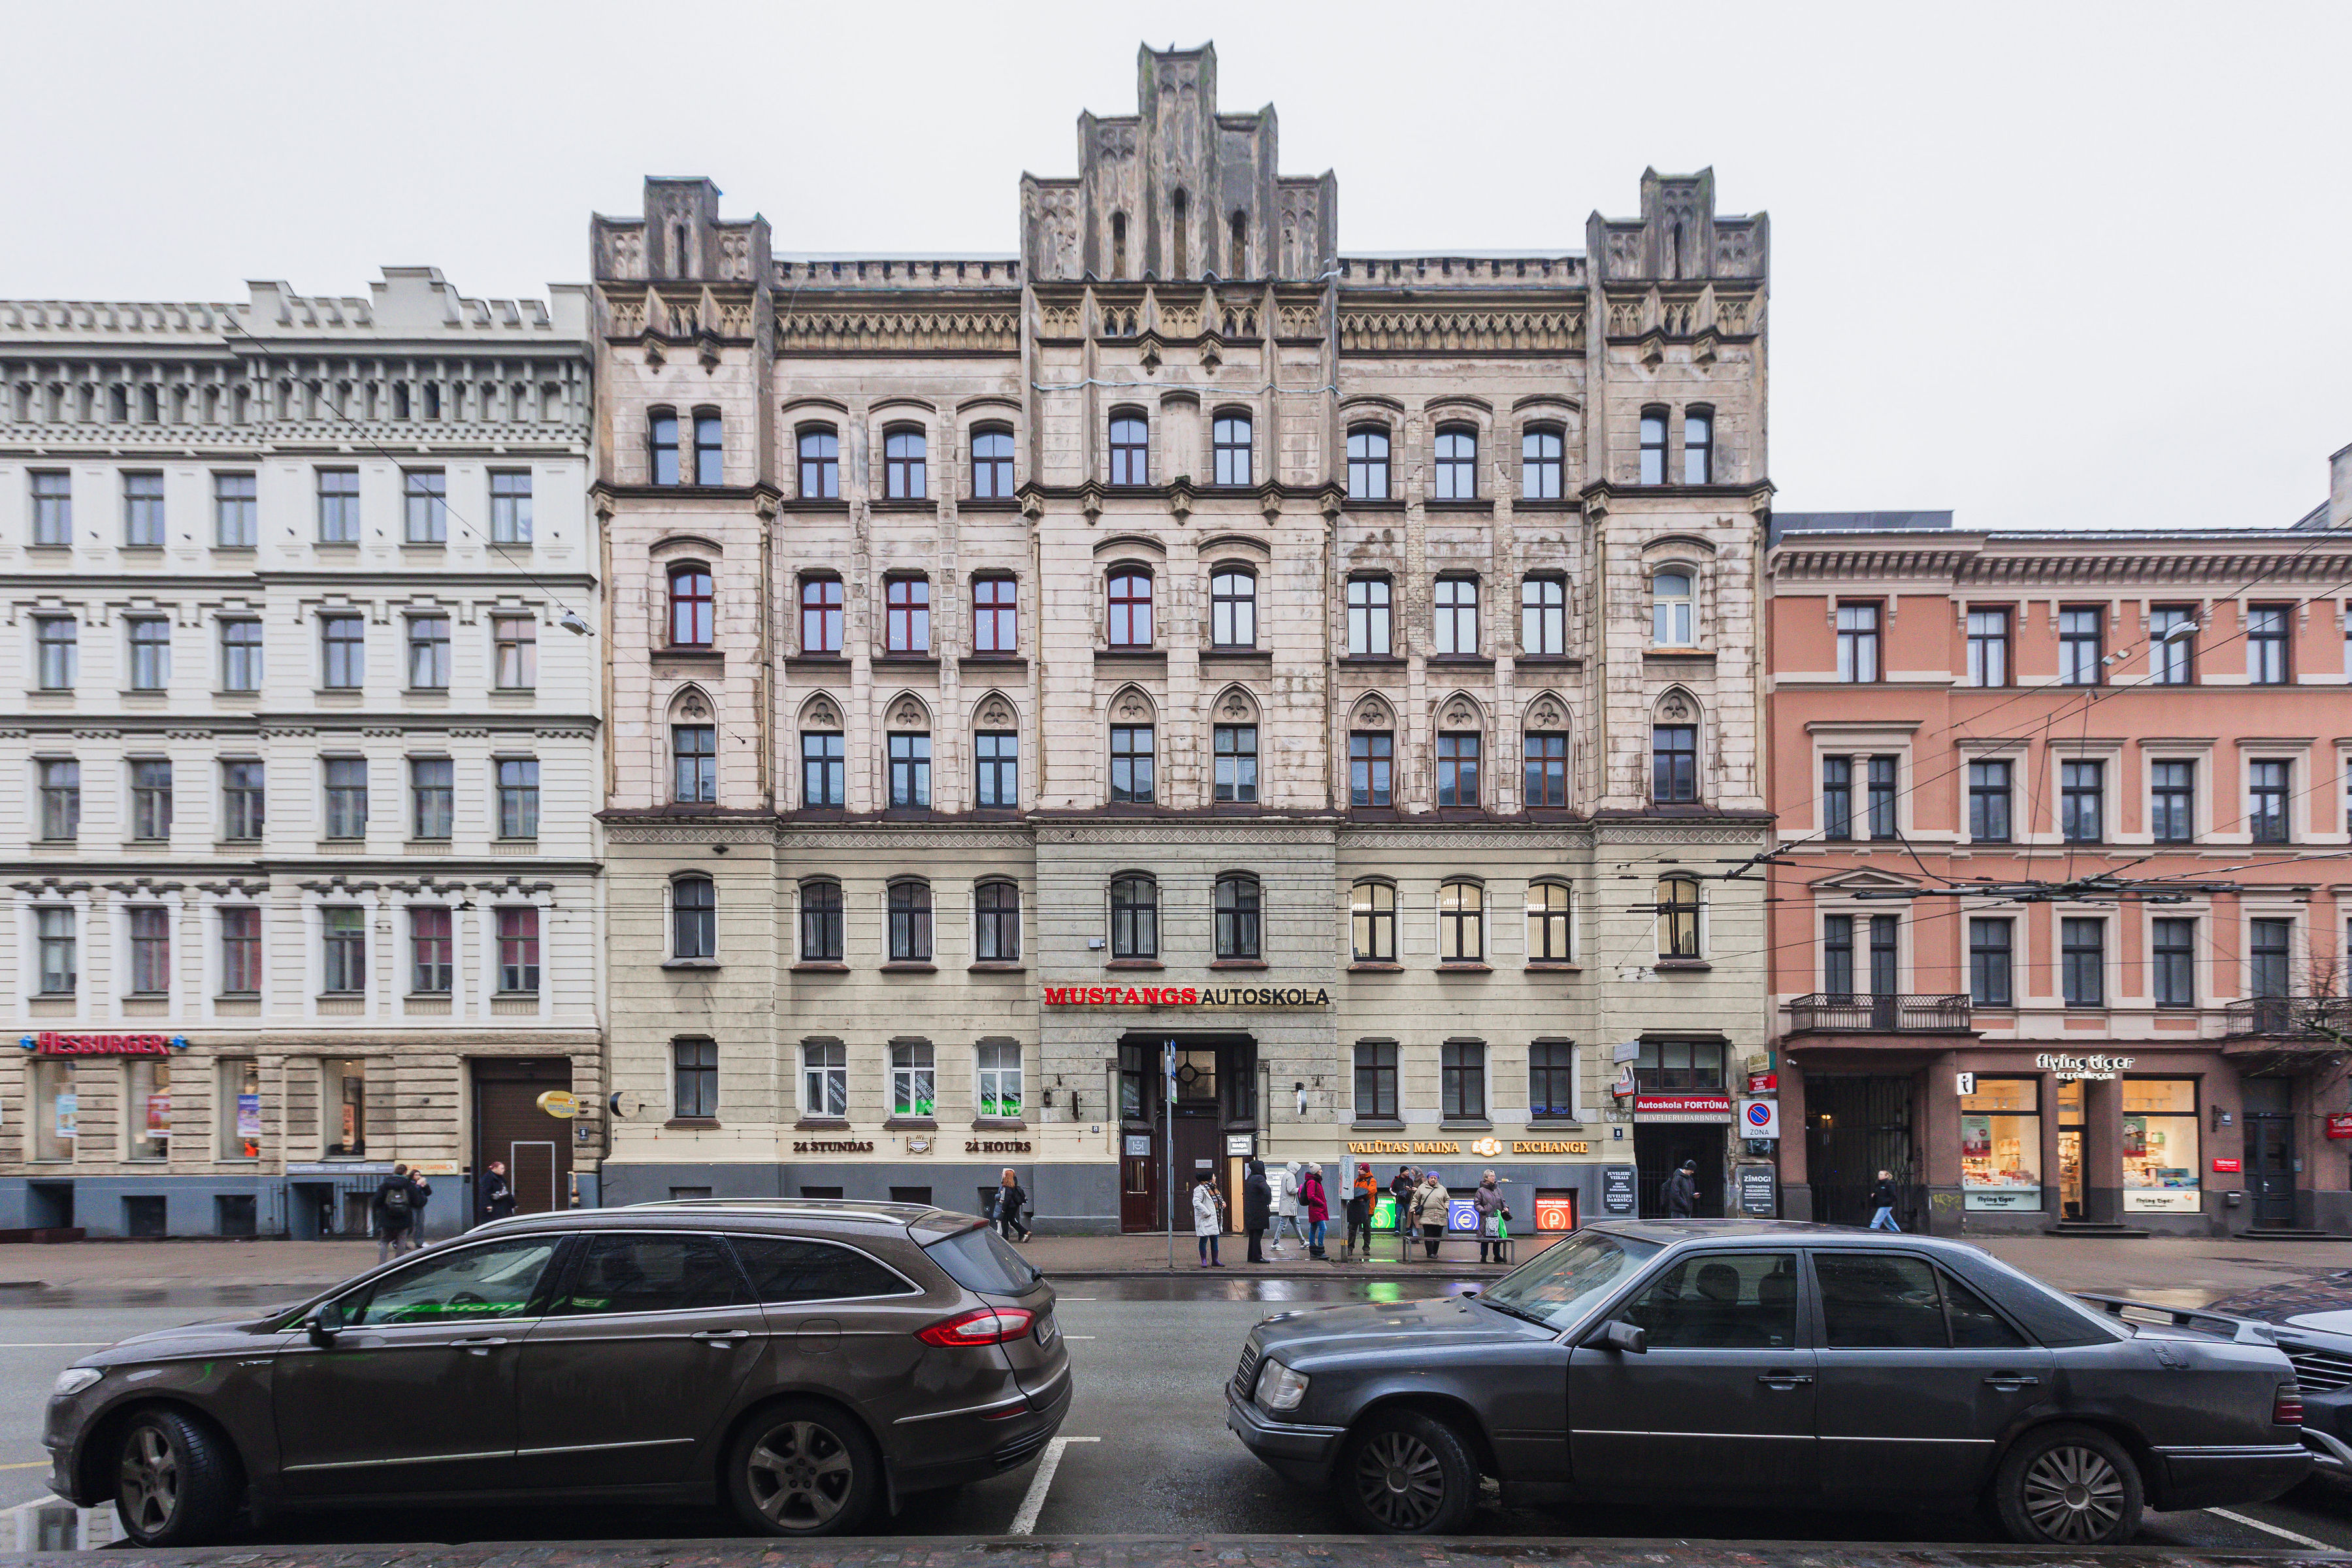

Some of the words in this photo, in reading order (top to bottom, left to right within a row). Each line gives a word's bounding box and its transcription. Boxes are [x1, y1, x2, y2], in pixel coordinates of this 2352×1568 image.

[1044, 987, 1197, 1005] MUSTANGS
[1201, 988, 1330, 1005] AUTOSKOLA
[38, 1032, 170, 1055] HESBURGER
[2036, 1053, 2088, 1071] flying
[2089, 1054, 2134, 1071] tiger
[829, 1076, 847, 1095] MEDICAL
[828, 1087, 847, 1109] PEDICURE
[1637, 1101, 1682, 1109] Autoskola
[1684, 1100, 1729, 1109] FORTŪNA
[1643, 1114, 1682, 1122] JUVELIERU
[1684, 1113, 1722, 1122] DARBNĪCA
[792, 1141, 809, 1152] 24
[810, 1141, 874, 1152] STUNDAS
[964, 1141, 979, 1152] 24
[983, 1141, 1032, 1152] HOURS
[1348, 1140, 1410, 1153] VALŪTAS
[1413, 1142, 1461, 1154] MAIŅA
[1512, 1141, 1588, 1153] EXCHANGE
[1458, 1213, 1472, 1228] €
